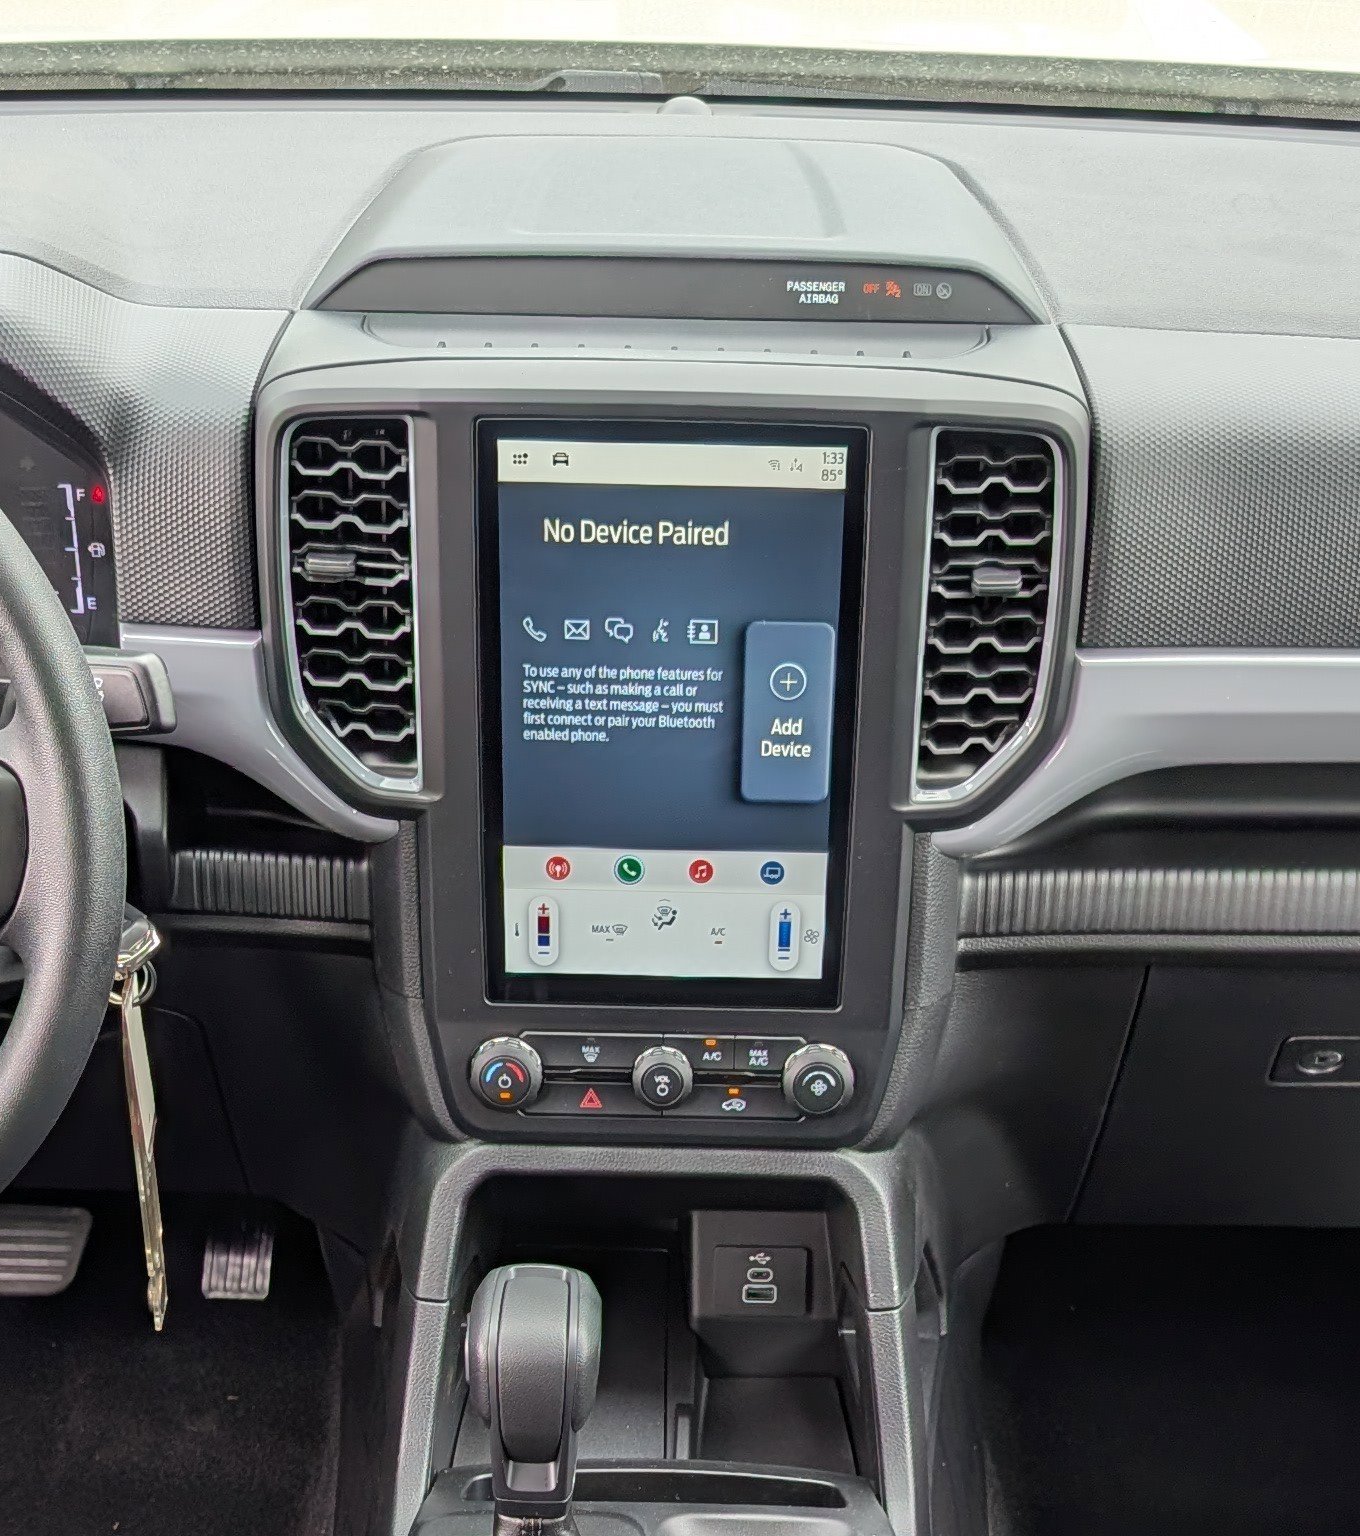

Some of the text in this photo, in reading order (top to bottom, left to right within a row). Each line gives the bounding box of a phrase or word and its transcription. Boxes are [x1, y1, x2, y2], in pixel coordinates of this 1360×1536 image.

[786, 280, 846, 292] PASSENGER
[863, 283, 880, 294] OFF
[798, 293, 839, 305] AIRBAG
[821, 451, 845, 466] 1:33
[543, 517, 730, 547] No Device Paired
[522, 663, 723, 682] To use any of the phone features for
[522, 680, 556, 694] SYNC
[566, 681, 593, 695] such
[594, 684, 609, 695] as
[609, 682, 653, 698] making
[654, 686, 661, 696] a
[662, 683, 684, 697] call
[685, 686, 698, 697] or
[522, 696, 574, 712] receiving
[574, 700, 582, 710] a
[583, 698, 608, 711] text
[609, 701, 660, 714] message
[670, 702, 693, 714] you
[694, 701, 724, 714] must
[522, 711, 716, 730] first connect or pair your Bluetooth
[770, 717, 803, 737] Add
[522, 727, 610, 743] enabled phone.
[760, 739, 811, 759] Device
[591, 924, 611, 934] MAX
[710, 927, 727, 937] A/C
[702, 1051, 722, 1061] A/C
[748, 1056, 769, 1067] A/C
